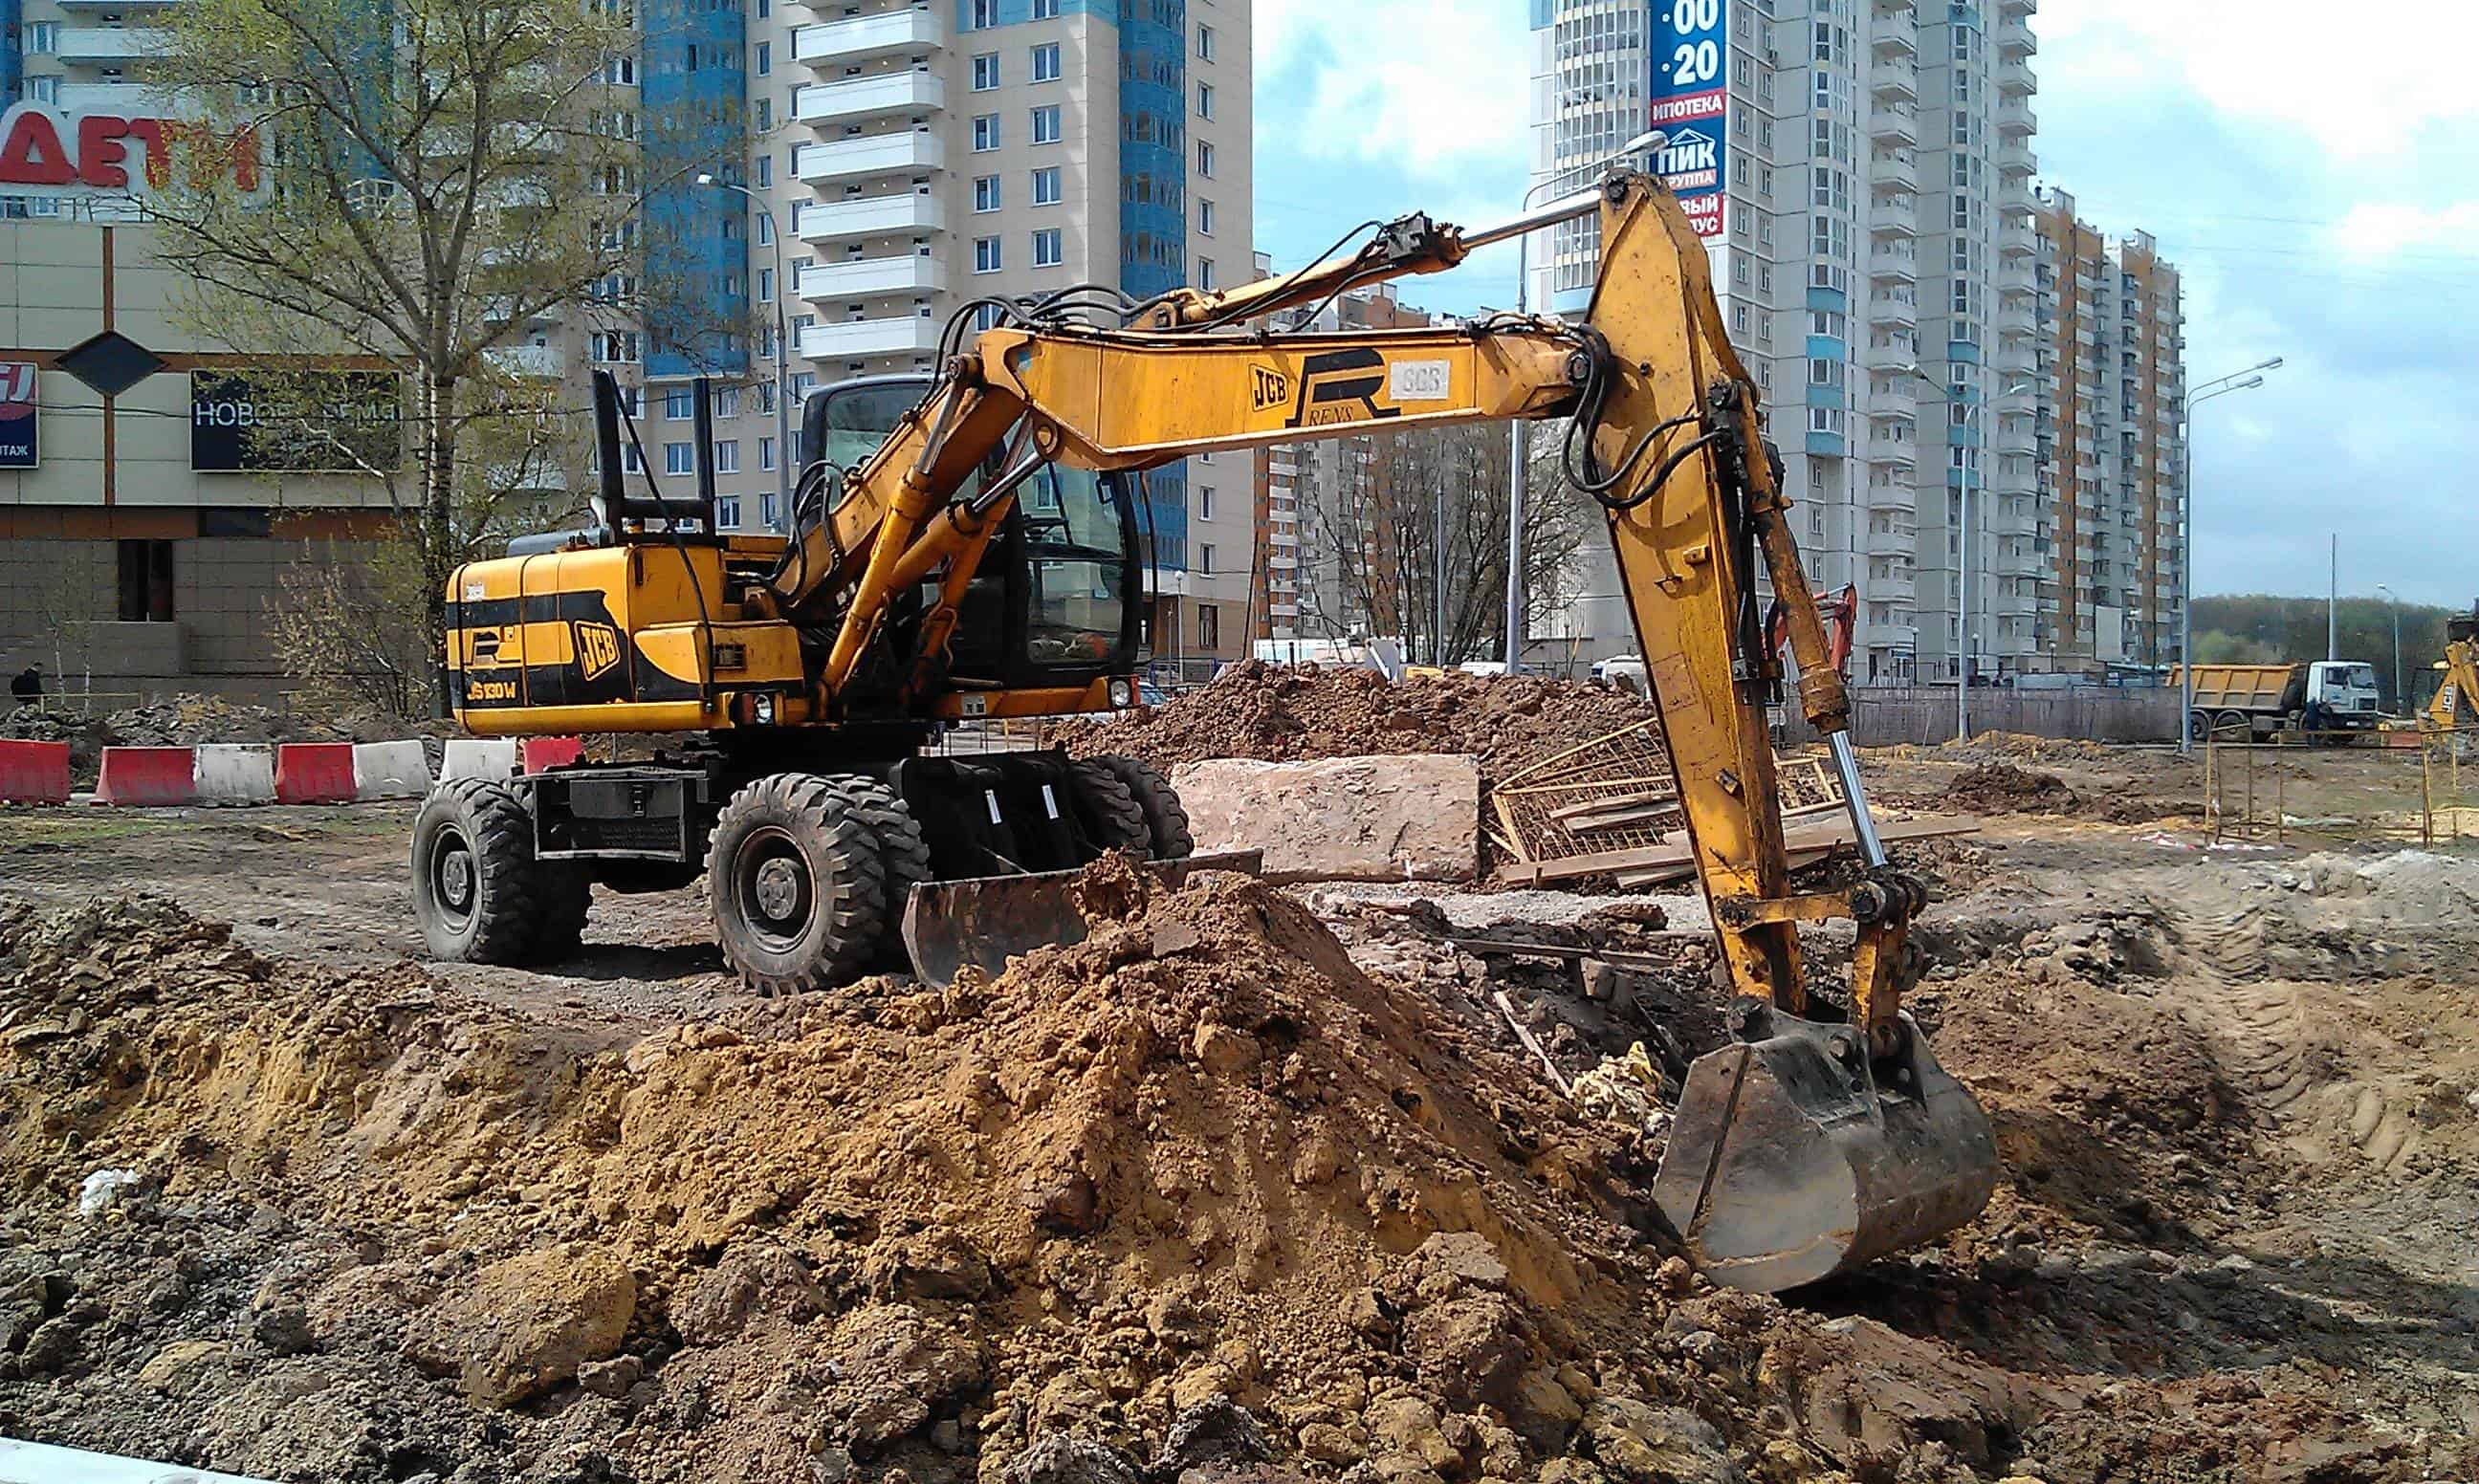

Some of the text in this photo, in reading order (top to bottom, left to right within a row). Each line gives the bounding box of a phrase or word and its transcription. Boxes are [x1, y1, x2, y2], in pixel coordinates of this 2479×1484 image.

[1674, 40, 1719, 86] 20
[1653, 95, 1722, 121] ИПОТЕКА
[0, 111, 260, 191] ДЕТИ
[1658, 142, 1717, 174] ПИК
[1667, 170, 1714, 188] РУППА
[1679, 194, 1719, 215] ВЫЙ
[1254, 369, 1286, 407] JCB
[0, 445, 28, 456] ТАЖ
[581, 626, 617, 675] JCB
